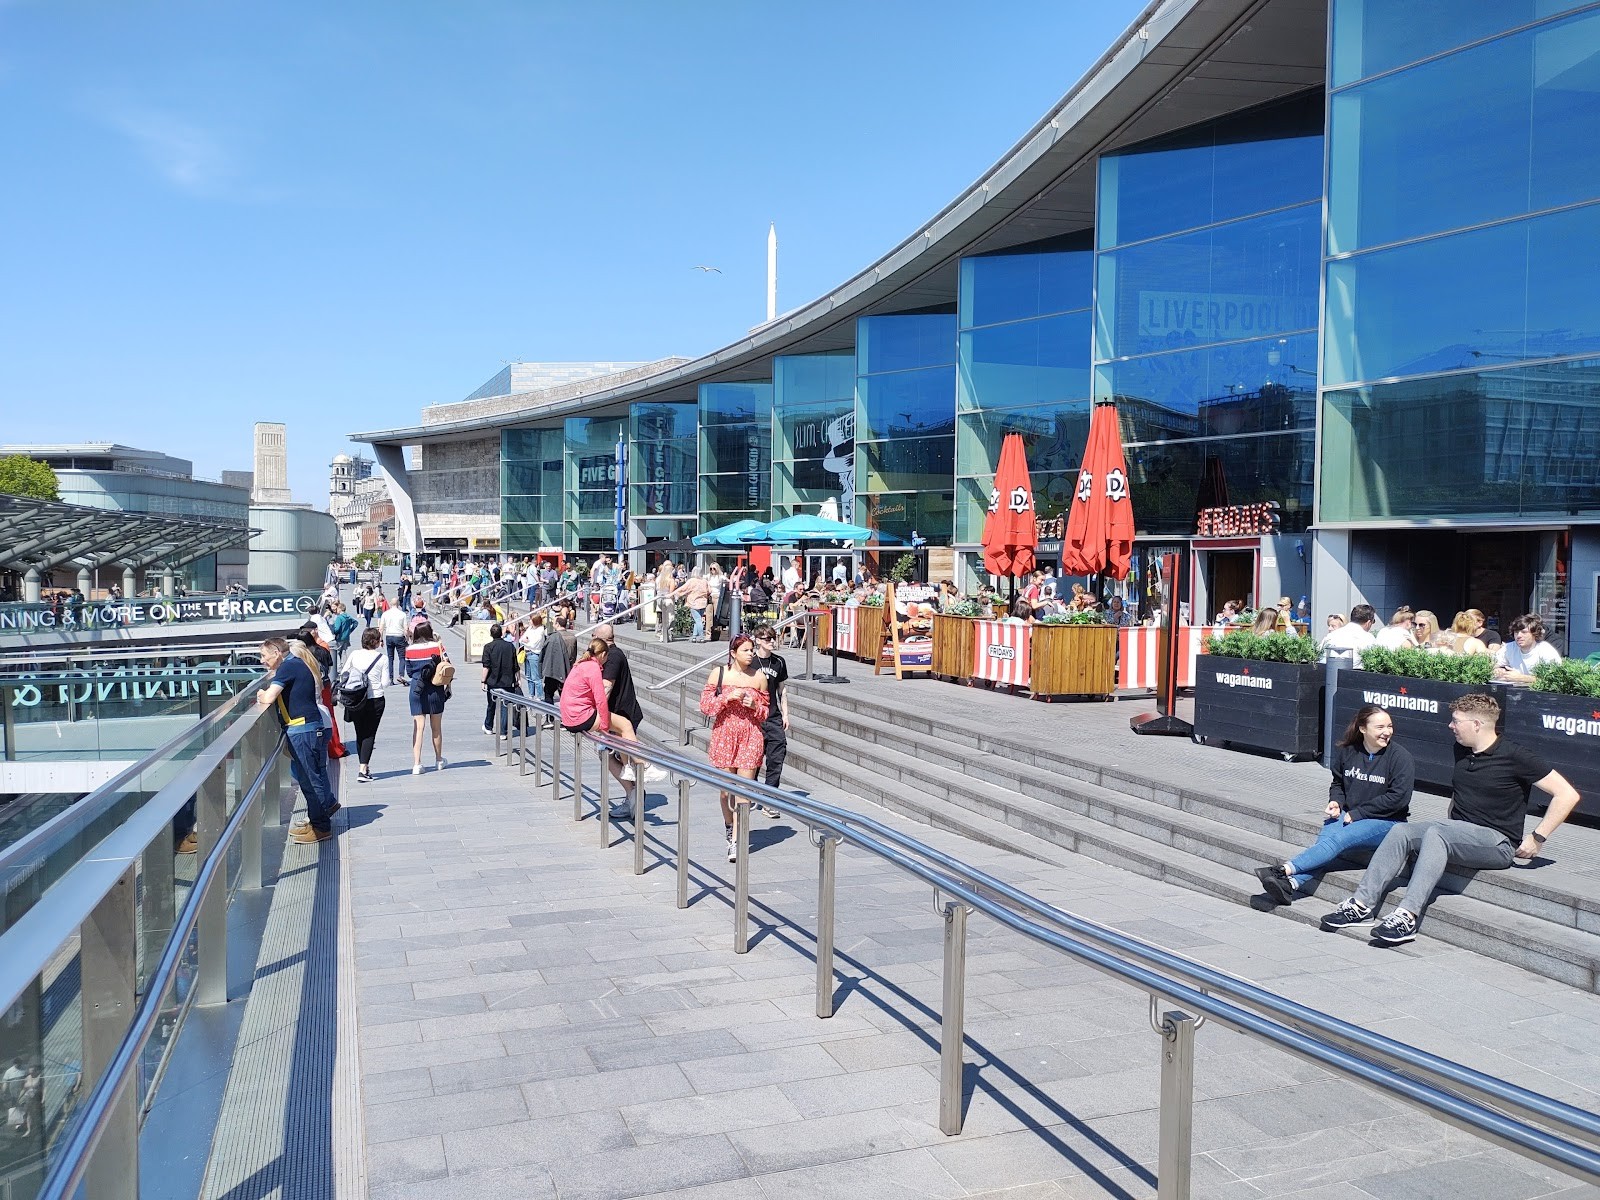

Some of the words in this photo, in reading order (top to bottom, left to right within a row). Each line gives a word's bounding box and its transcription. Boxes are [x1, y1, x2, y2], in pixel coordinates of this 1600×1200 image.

[1149, 299, 1282, 332] LIVERPOOL
[581, 465, 606, 482] FIVE
[655, 466, 665, 514] GUYS
[871, 503, 905, 517] Cocktails
[82, 605, 145, 624] MORE
[150, 604, 181, 620] ON
[182, 602, 201, 611] THE
[204, 598, 294, 617] TERRACE
[989, 646, 1013, 658] FRIDAYS
[1215, 672, 1272, 690] wagamama
[1363, 690, 1439, 713] wagamama
